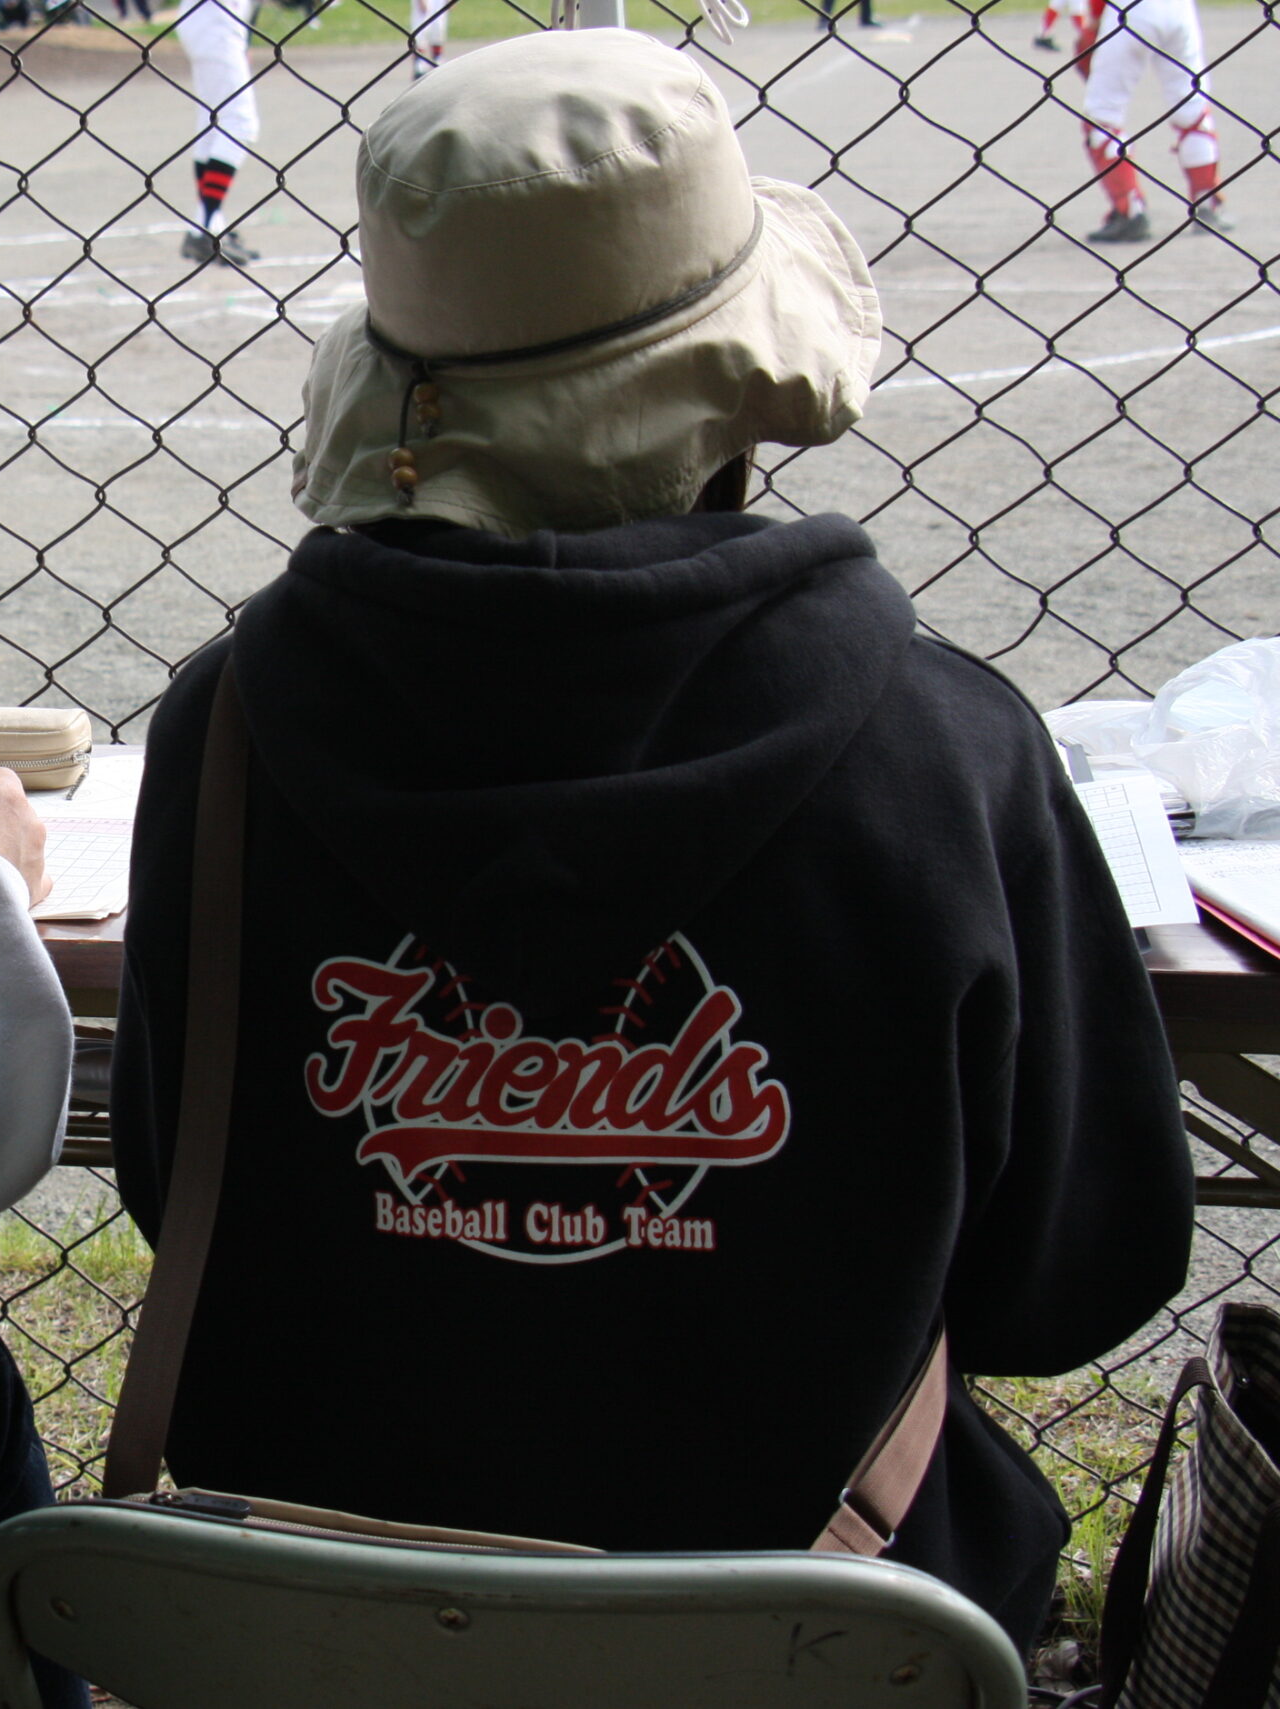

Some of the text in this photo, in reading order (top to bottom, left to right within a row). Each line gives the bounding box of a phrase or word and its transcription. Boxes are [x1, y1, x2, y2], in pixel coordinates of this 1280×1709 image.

[305, 956, 790, 1180] Friends
[373, 1190, 716, 1251] Baseball Club Team
